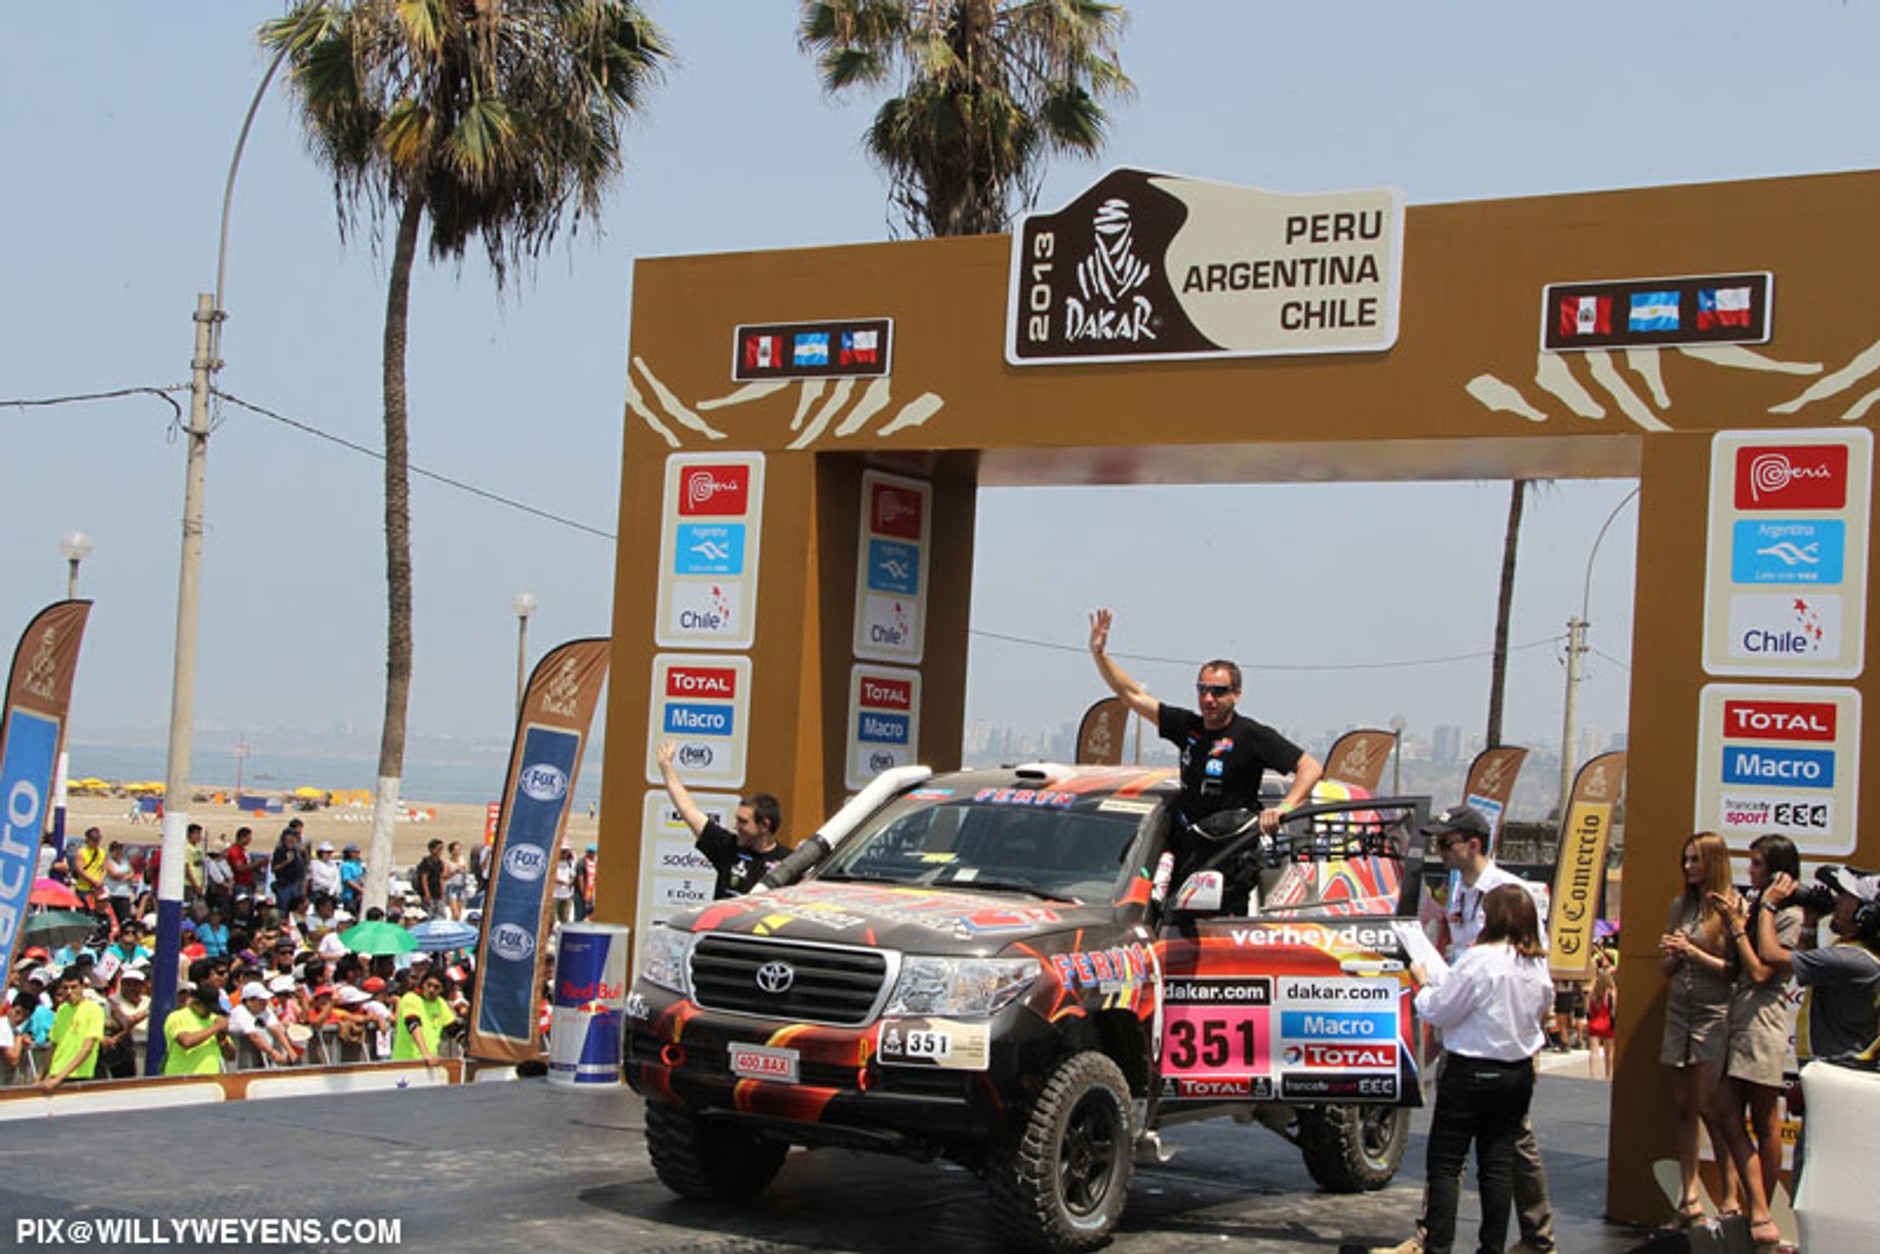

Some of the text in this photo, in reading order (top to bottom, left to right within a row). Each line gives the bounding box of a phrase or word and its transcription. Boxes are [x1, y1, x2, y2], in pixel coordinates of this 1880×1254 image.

[1285, 211, 1383, 244] PERU
[1182, 254, 1379, 294] ARGENTINA
[1029, 231, 1054, 342] 2013
[1064, 296, 1156, 342] DAKAR
[1280, 298, 1377, 330] CHILE
[680, 611, 720, 630] Chile
[871, 625, 901, 645] Chile
[1744, 630, 1807, 653] Chile
[672, 673, 730, 691] TOTAL
[865, 683, 906, 703] TOTAL
[672, 709, 725, 729] Macro
[865, 717, 903, 738] Macro
[1733, 709, 1827, 731] TOTAL
[1735, 753, 1821, 779] Macro
[531, 773, 556, 788] FOX
[1726, 812, 1769, 825] sport
[514, 850, 541, 867] FOX
[1562, 814, 1601, 922] Comercio
[0, 778, 40, 988] acro
[500, 930, 523, 946] FOX
[1231, 924, 1397, 950] verheyden
[1557, 927, 1582, 954] El
[562, 981, 594, 999] Red
[1164, 983, 1265, 1000] dakar.com
[1286, 984, 1389, 1000] dakar.com
[1304, 1016, 1374, 1035] Macro
[909, 1034, 947, 1053] 351
[1169, 1020, 1255, 1069] 351
[1308, 1047, 1393, 1065] TOTAL
[1181, 1080, 1249, 1095] TOTAL
